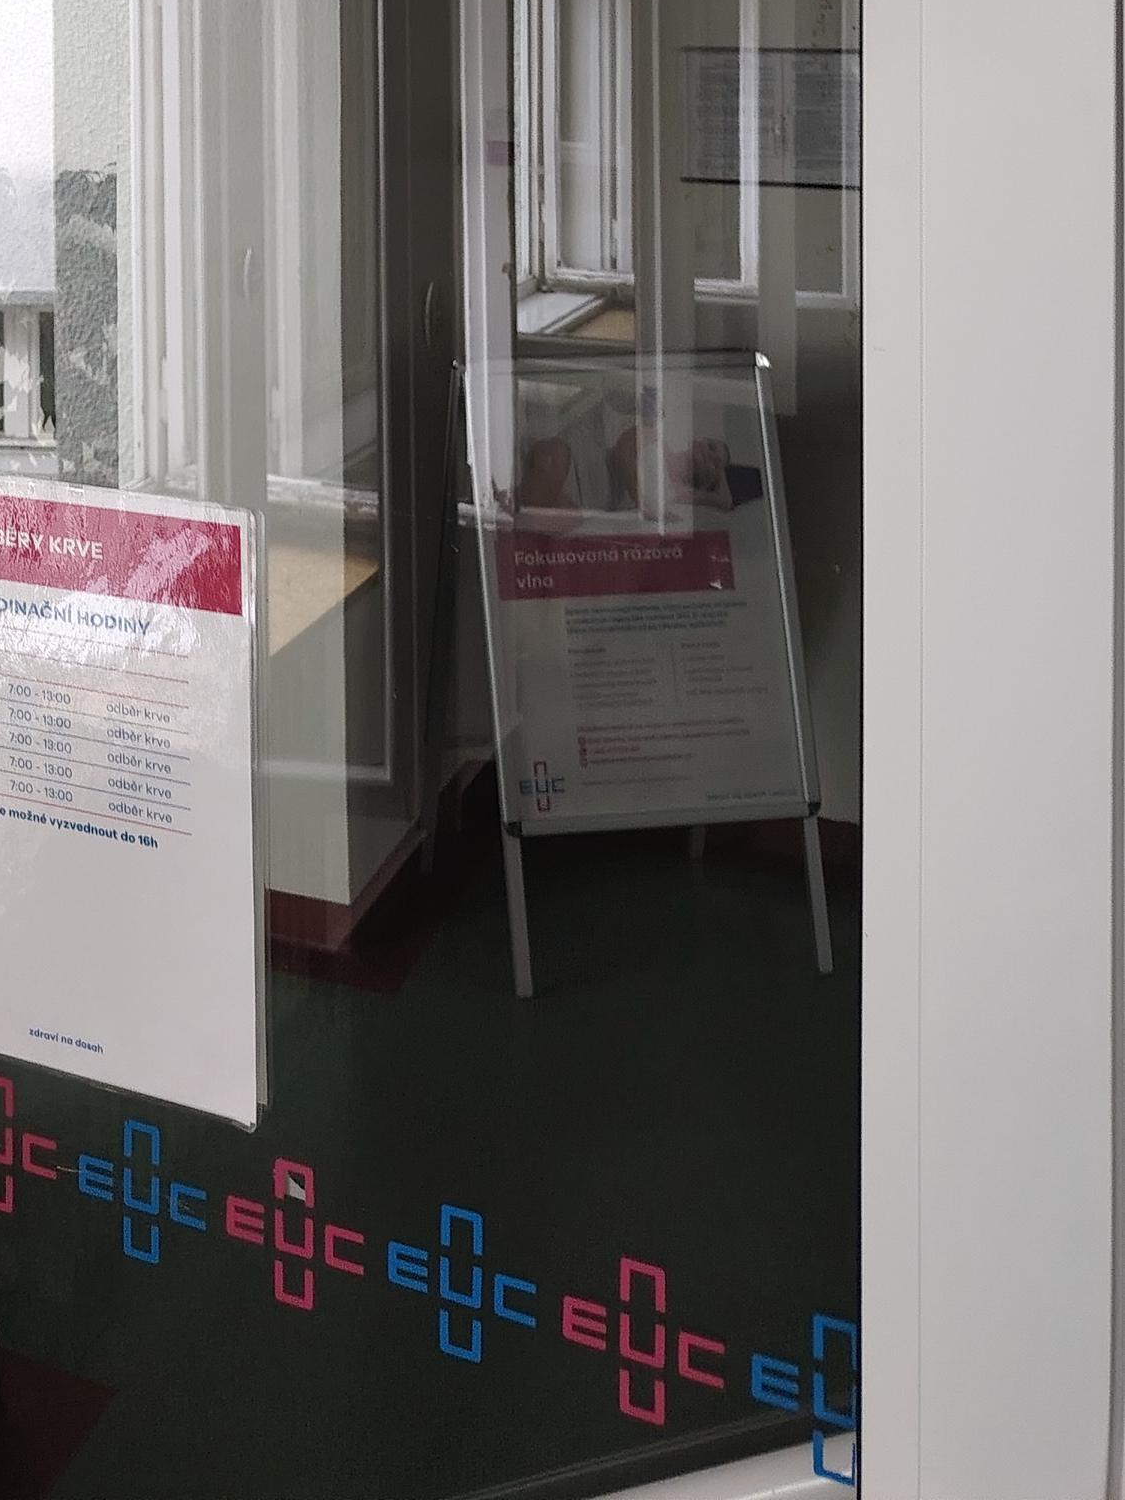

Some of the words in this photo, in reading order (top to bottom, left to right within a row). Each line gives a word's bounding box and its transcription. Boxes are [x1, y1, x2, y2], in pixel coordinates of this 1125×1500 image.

[48, 535, 104, 561] KRVE
[515, 573, 553, 589] vlna
[77, 612, 151, 637] HODINY
[8, 683, 31, 697] 7:00
[42, 690, 71, 705] 13:00
[8, 707, 31, 721] 7:00
[42, 714, 71, 729] 13:00
[9, 731, 32, 745] 7:00
[43, 738, 72, 753] 13:00
[9, 756, 32, 770] 7:00
[43, 762, 72, 778] 13:00
[10, 780, 33, 794] 7:00
[44, 786, 73, 802] 13:00
[8, 809, 47, 825] možné
[50, 817, 118, 840] vyzvednout
[120, 831, 136, 843] do
[138, 834, 158, 849] 16h
[61, 1035, 73, 1045] na
[75, 1038, 104, 1054] dosah
